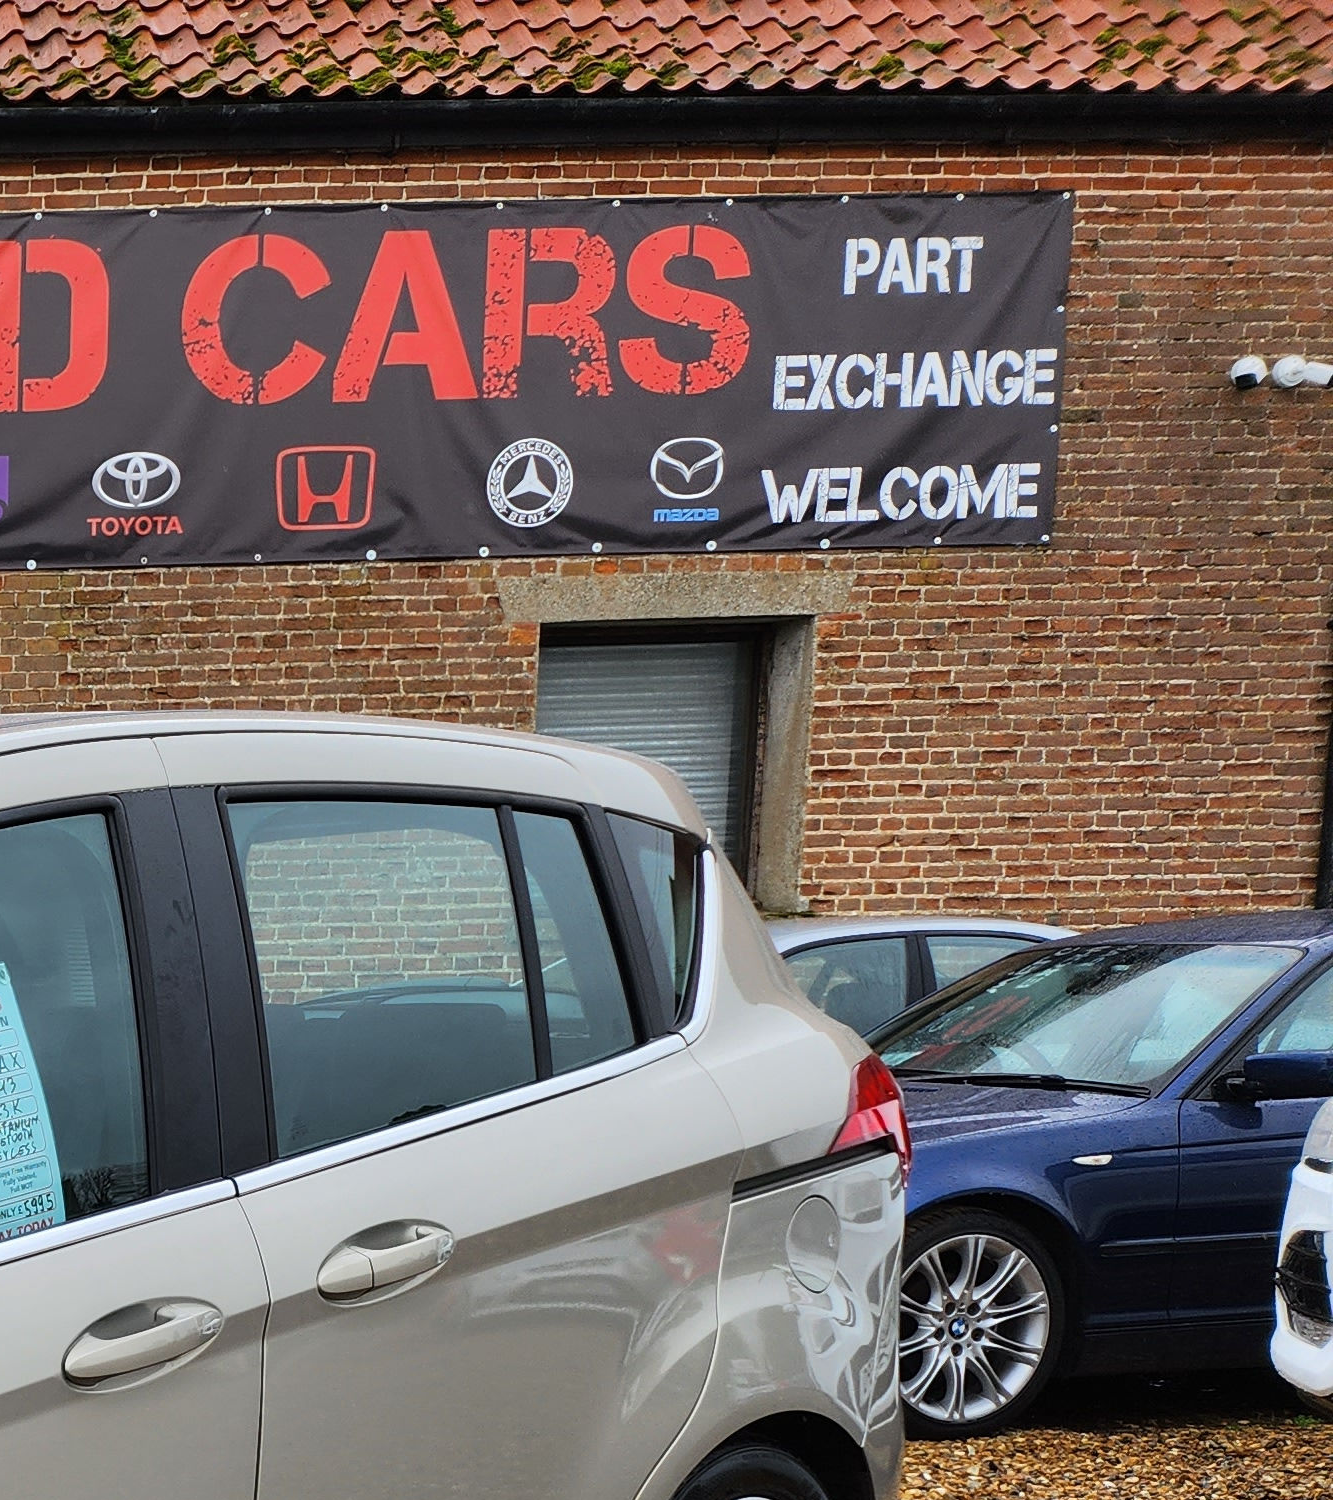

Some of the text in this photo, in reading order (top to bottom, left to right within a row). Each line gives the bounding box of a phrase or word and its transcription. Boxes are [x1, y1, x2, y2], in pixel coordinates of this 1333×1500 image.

[844, 236, 984, 295] PART
[182, 223, 751, 405] CARS
[772, 349, 1058, 411] EXCHANGE
[499, 441, 565, 465] MERCEDES
[508, 510, 546, 524] BENZ
[761, 464, 1040, 524] WELCOME
[87, 516, 183, 536] TOYOTA
